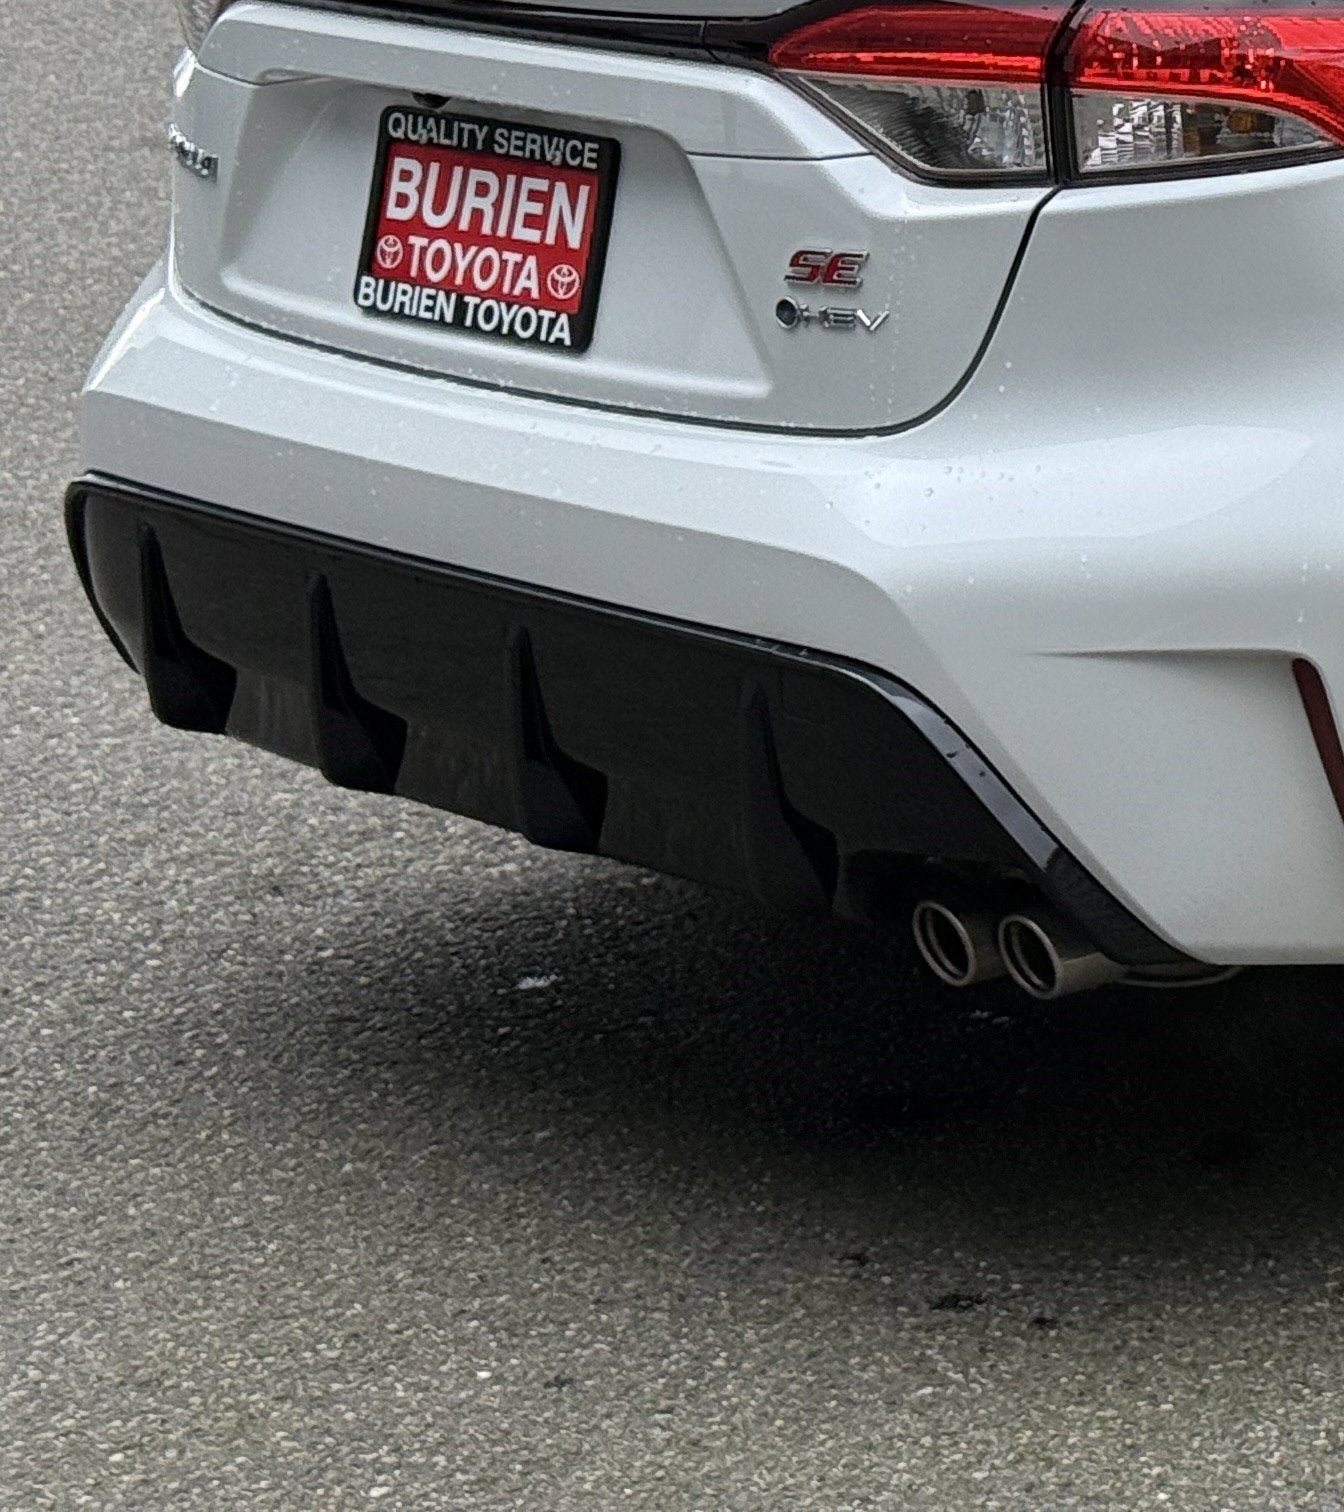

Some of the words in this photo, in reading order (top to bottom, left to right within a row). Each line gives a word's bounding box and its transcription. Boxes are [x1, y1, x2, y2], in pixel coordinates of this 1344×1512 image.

[387, 112, 488, 150] QUALITY
[493, 128, 599, 170] SERVICE
[385, 156, 591, 250] BURIEN
[407, 235, 540, 300] TOYOTA
[783, 248, 869, 288] SE
[357, 276, 457, 324] BURIEN
[463, 296, 572, 347] TOYOTA
